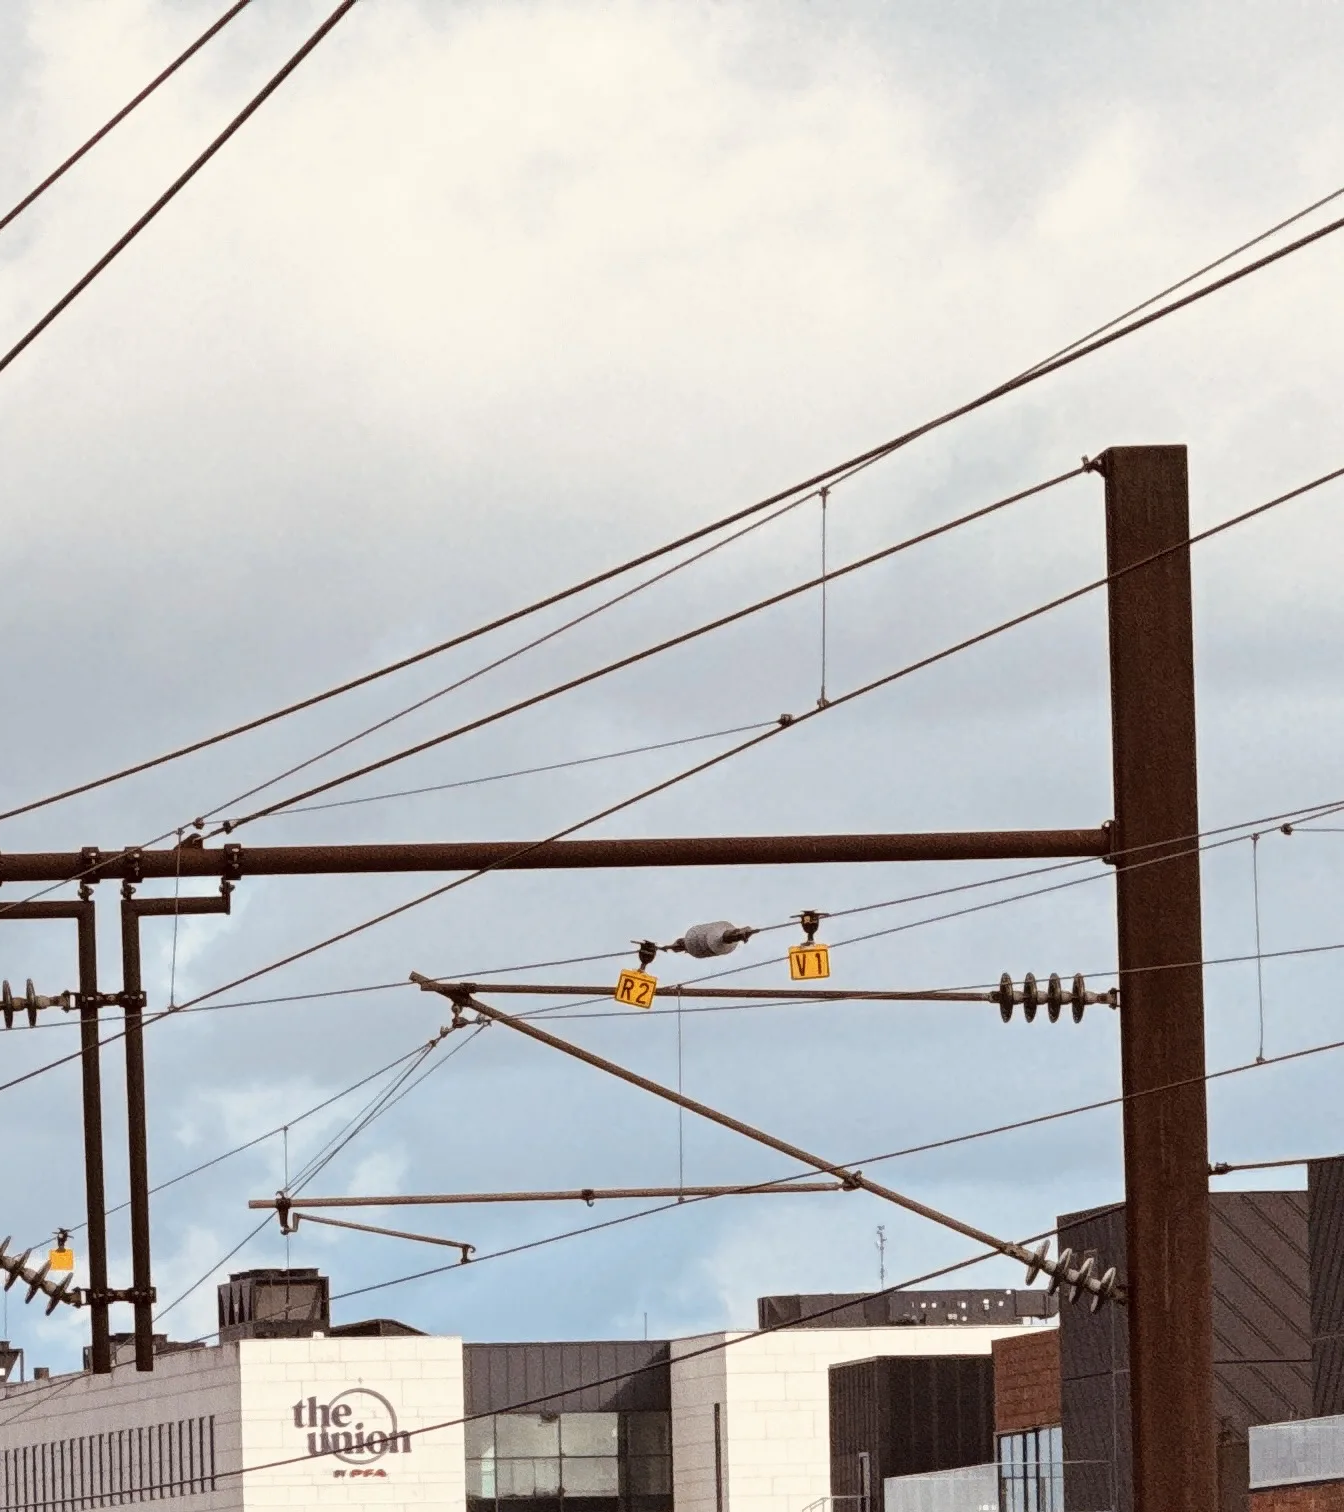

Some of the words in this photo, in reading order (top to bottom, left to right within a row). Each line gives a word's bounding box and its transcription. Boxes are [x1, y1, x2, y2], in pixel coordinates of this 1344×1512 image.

[795, 953, 823, 976] V1
[621, 978, 650, 1005] R2
[291, 1396, 352, 1428] the
[306, 1422, 412, 1455] union
